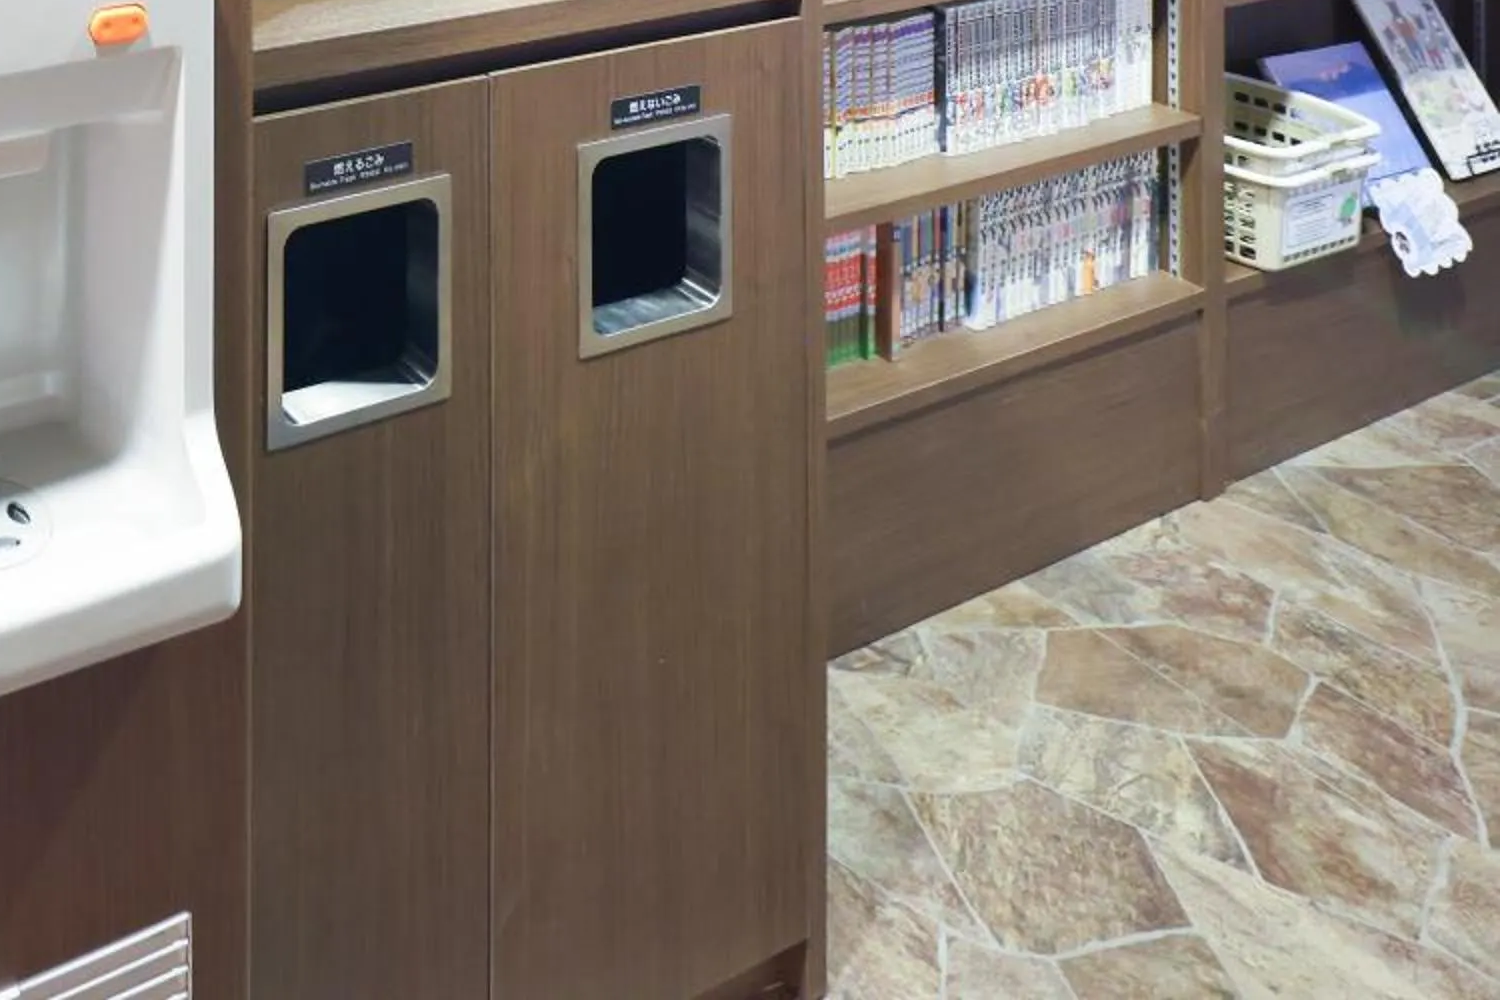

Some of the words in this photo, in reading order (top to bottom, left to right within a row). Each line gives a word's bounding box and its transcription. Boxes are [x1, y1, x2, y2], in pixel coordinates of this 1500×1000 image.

[629, 93, 681, 114] 燃えないごみ
[333, 153, 385, 177] 燃えるごみ
